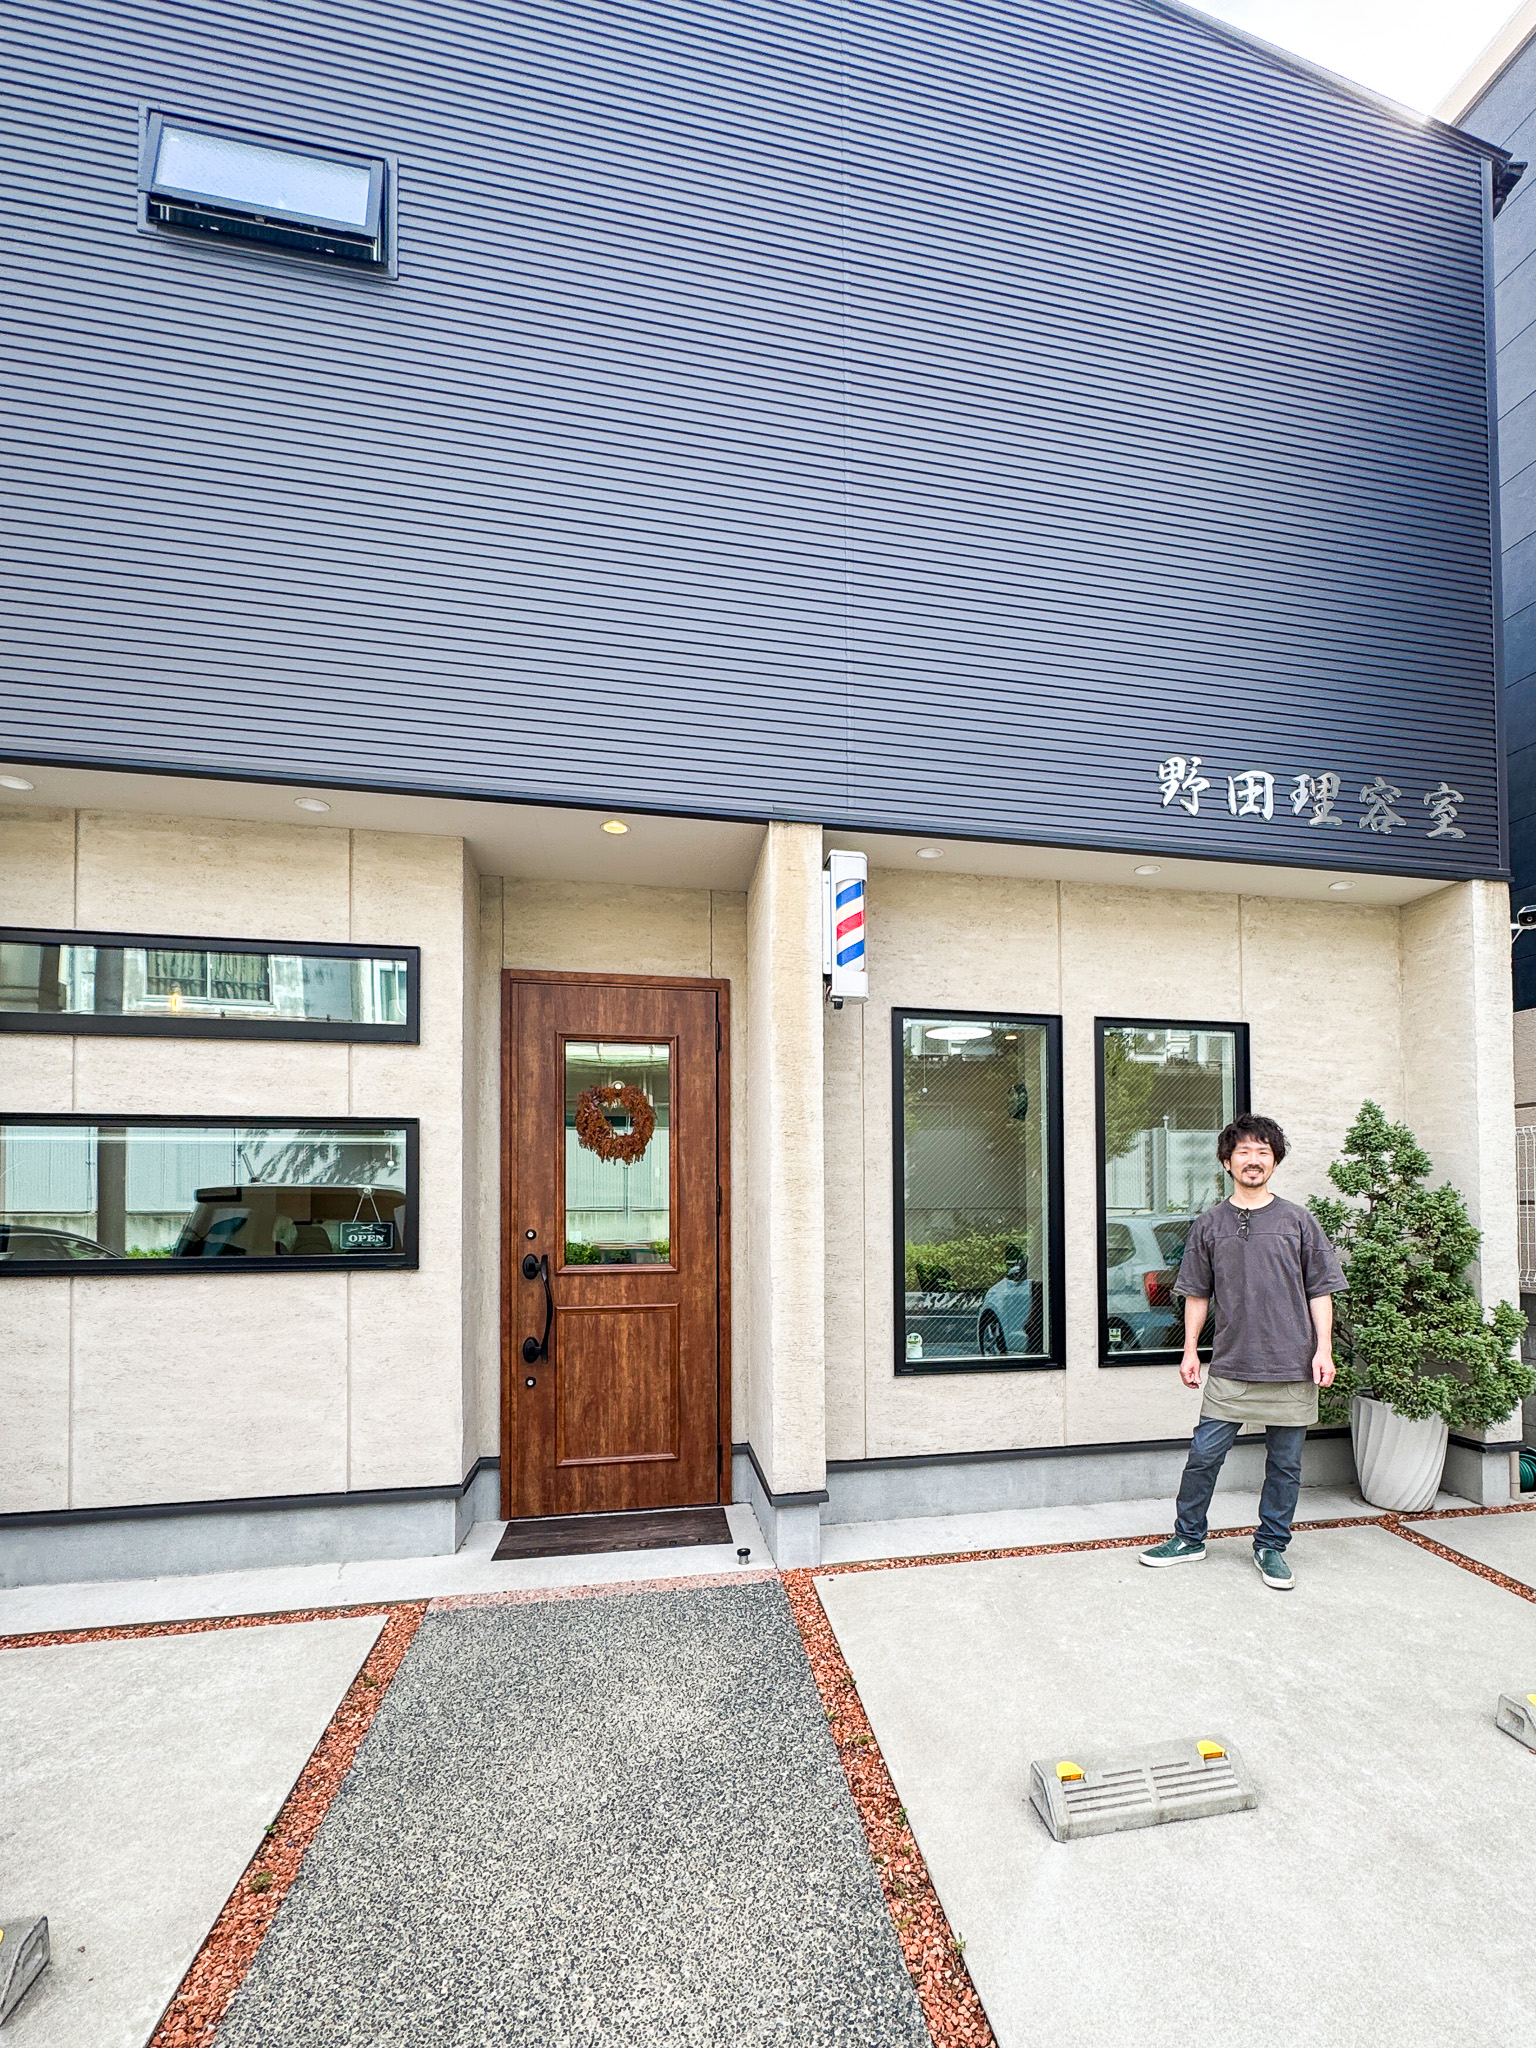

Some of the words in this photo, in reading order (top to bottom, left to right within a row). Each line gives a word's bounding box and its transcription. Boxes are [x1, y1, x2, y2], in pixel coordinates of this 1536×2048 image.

[1158, 756, 1467, 839] 野田理容室
[348, 1234, 385, 1243] OPEN
